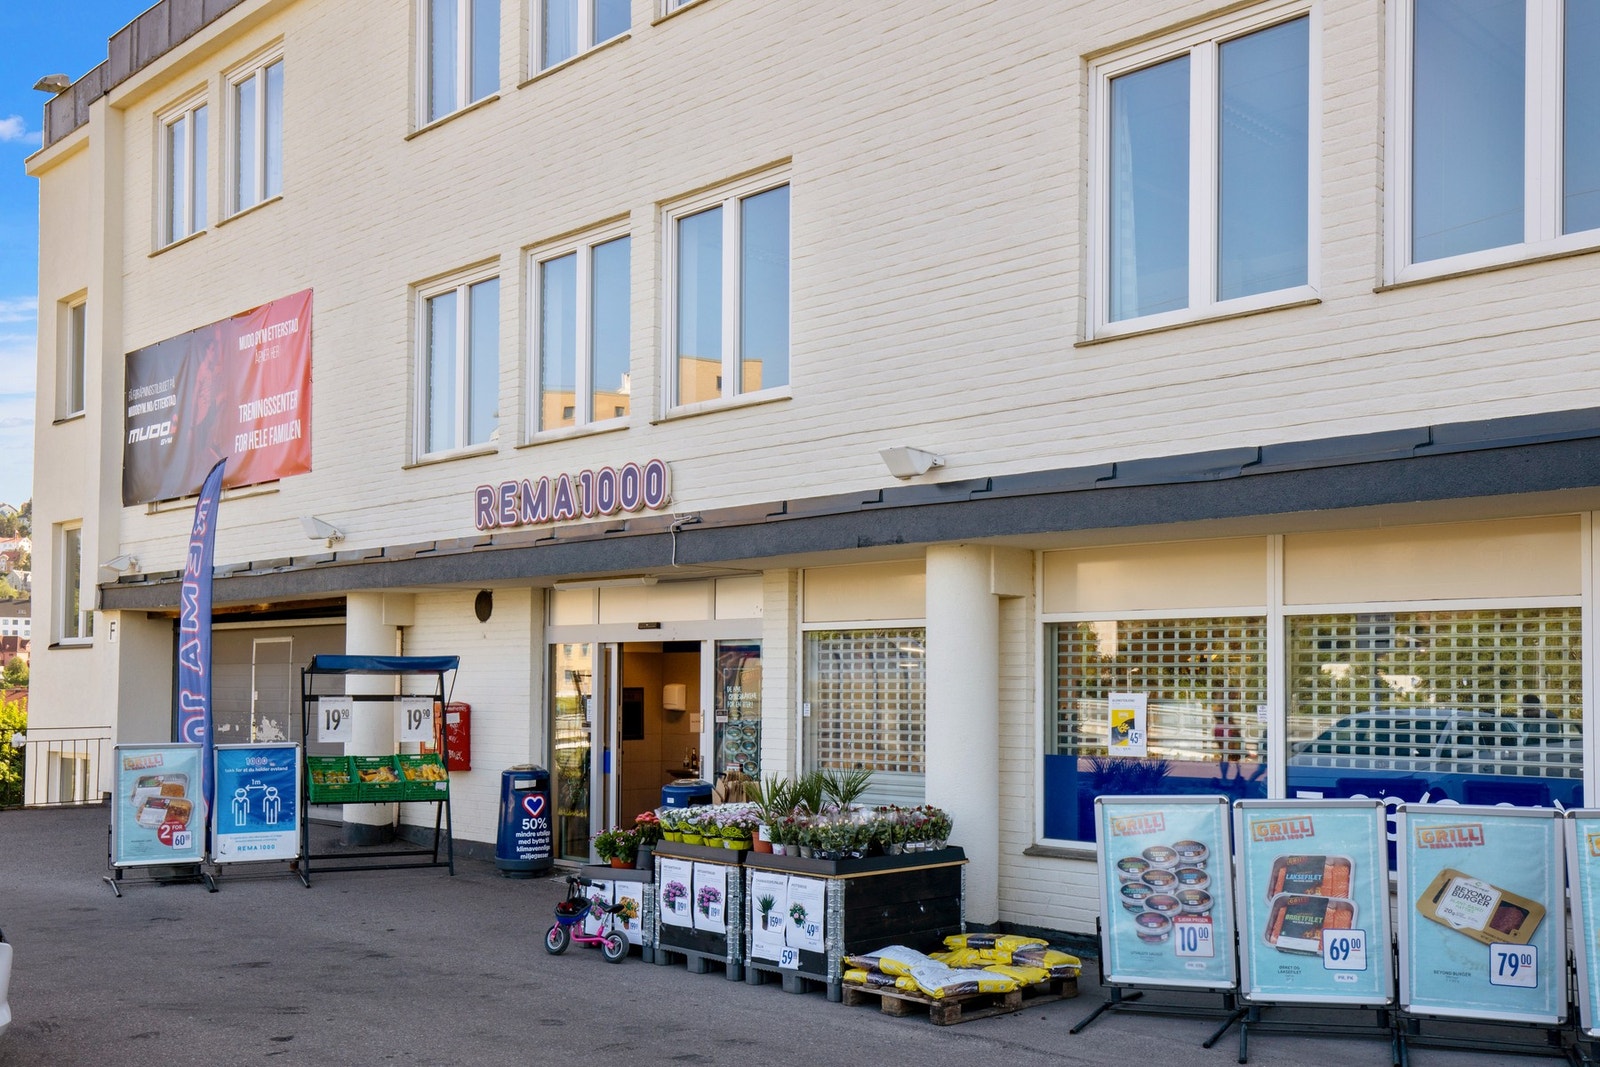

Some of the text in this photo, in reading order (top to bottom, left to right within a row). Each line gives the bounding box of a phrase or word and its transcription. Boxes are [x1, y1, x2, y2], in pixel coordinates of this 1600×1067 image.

[268, 318, 299, 341] ETTERSTAD
[239, 389, 299, 423] TRENINGSSENTER
[234, 419, 302, 453] FOR HELE FAMILIEN
[109, 621, 117, 641] F
[245, 756, 268, 766] 1000
[251, 778, 262, 786] 1m
[522, 818, 547, 830] 50%
[1115, 814, 1162, 831] GRILL
[1257, 820, 1310, 837] GRILL
[160, 824, 171, 839] 2
[1421, 828, 1479, 844] GRILL
[237, 844, 258, 852] REMA
[531, 838, 545, 846] bytte
[1429, 842, 1453, 850] REMA
[1286, 873, 1323, 881] LAKSEFILET
[1451, 890, 1490, 907] BURGER
[1454, 885, 1492, 901] BEYOND
